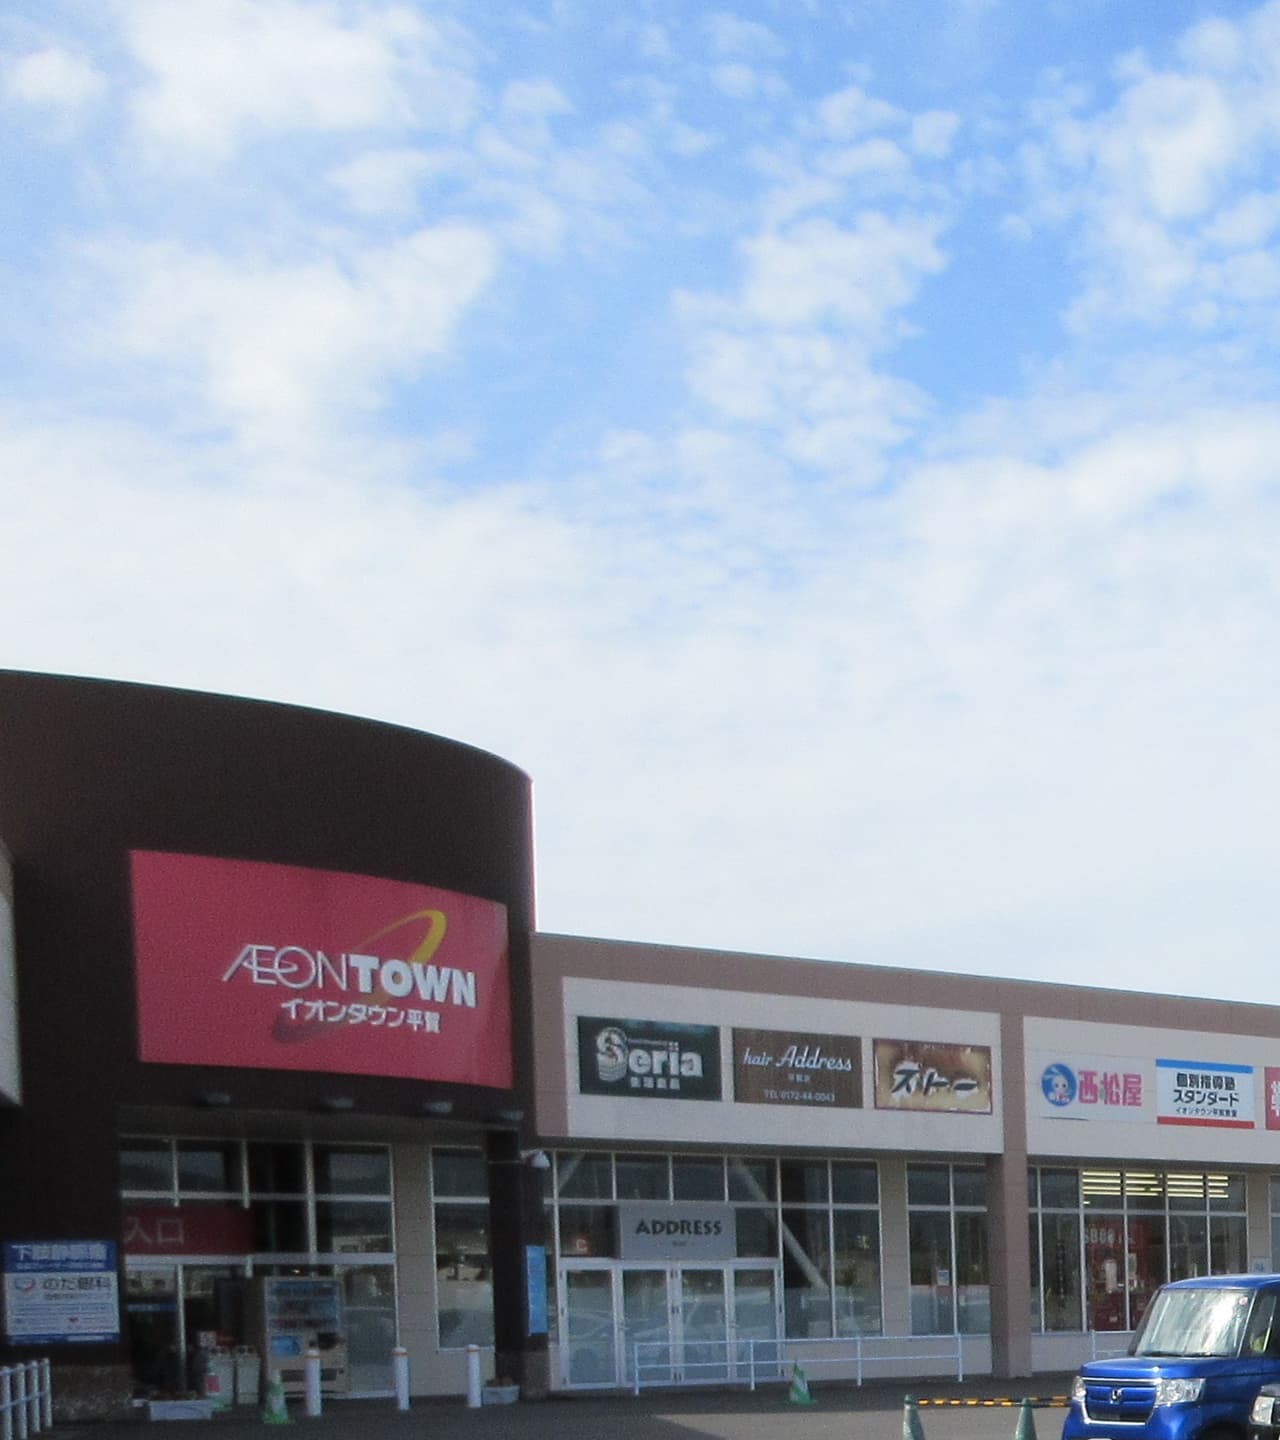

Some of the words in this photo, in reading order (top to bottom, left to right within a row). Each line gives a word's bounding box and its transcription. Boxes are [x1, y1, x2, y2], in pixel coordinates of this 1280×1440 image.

[281, 998, 440, 1033] イオンタウン平賀
[596, 1027, 703, 1082] Seria
[743, 1047, 773, 1066] hair
[775, 1045, 852, 1072] Address
[1078, 1070, 1142, 1106] 西松屋
[1173, 1089, 1240, 1107] スタンダード
[635, 1219, 723, 1236] ADDRESS
